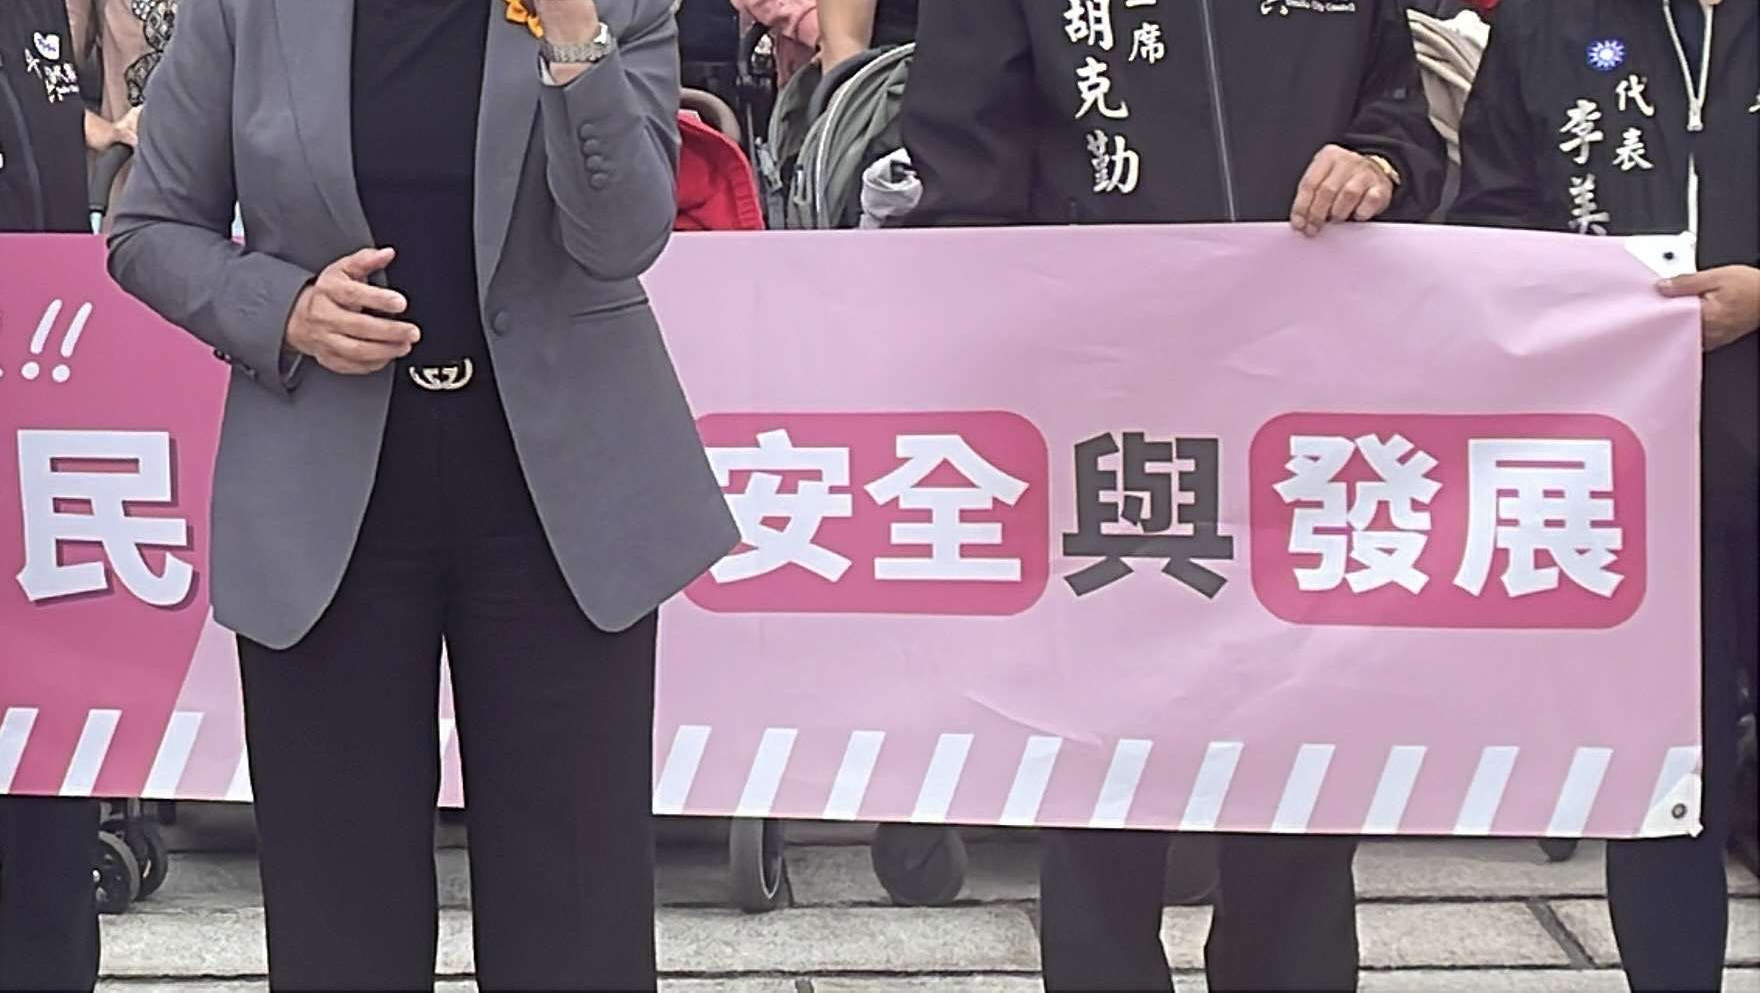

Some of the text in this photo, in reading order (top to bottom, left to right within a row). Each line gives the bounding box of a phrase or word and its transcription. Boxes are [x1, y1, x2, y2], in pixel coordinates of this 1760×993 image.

[1611, 74, 1656, 171] 代表
[704, 427, 1625, 599] 安全與發展
